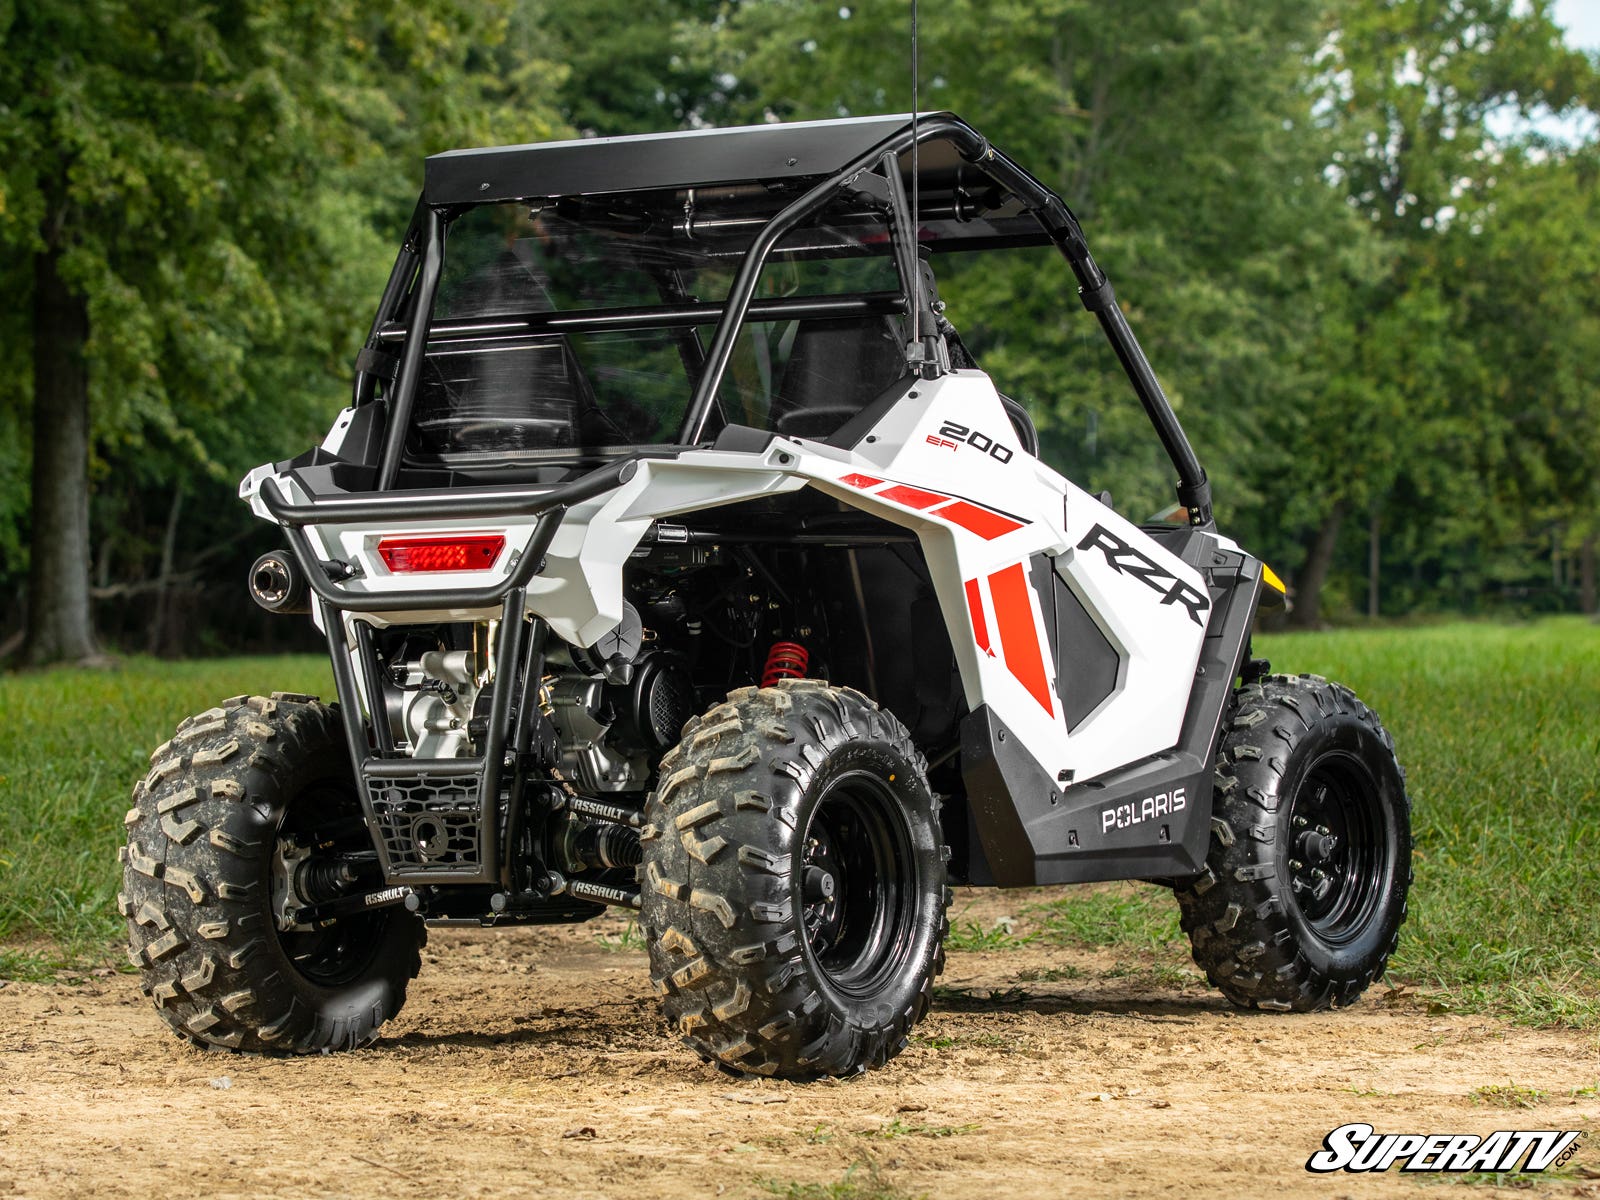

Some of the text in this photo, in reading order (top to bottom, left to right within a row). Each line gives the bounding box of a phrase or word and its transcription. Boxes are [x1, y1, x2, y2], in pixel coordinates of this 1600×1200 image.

[926, 435, 958, 452] EFI
[939, 420, 1013, 465] 200
[1077, 523, 1210, 627] RZR
[574, 800, 624, 820] ASSAULT
[1102, 788, 1185, 834] POLARIS
[365, 886, 404, 906] ASSAULT
[576, 882, 627, 901] ASSAULT
